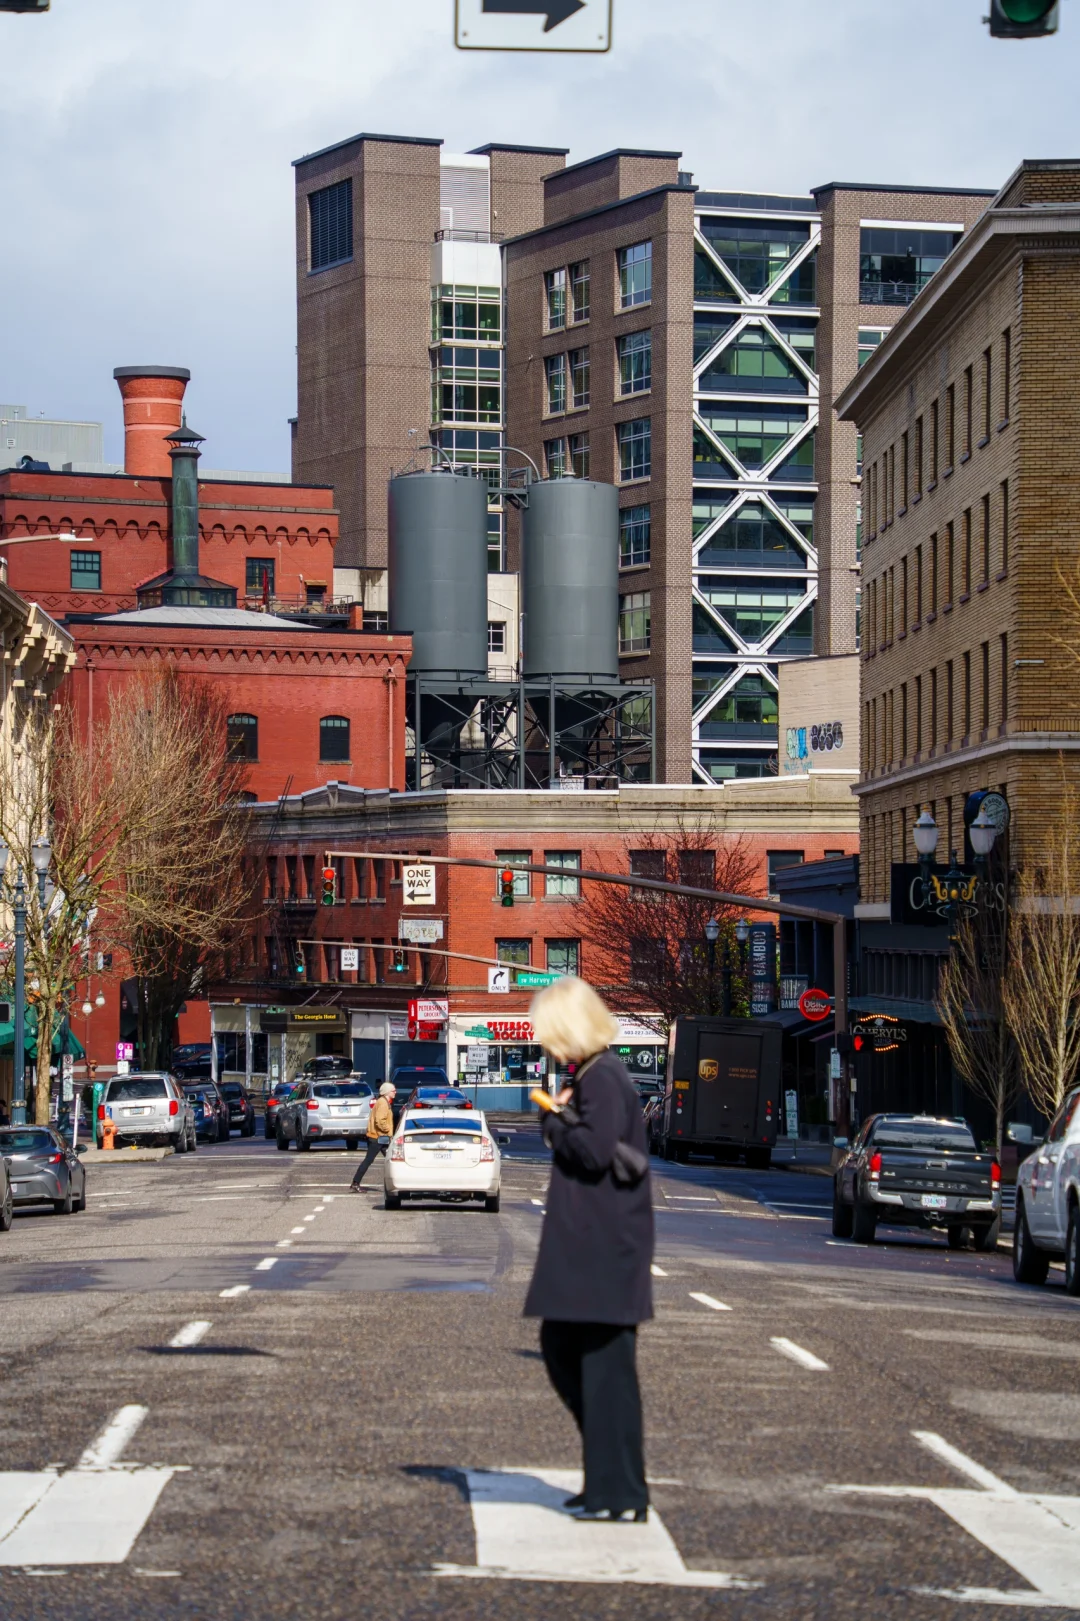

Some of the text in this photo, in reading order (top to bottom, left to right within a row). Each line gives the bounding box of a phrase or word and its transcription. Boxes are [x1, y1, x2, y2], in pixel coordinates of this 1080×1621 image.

[407, 869, 431, 878] ONE
[407, 880, 431, 888] WAY
[406, 927, 440, 938] HOTEL
[753, 931, 766, 976] BAMBOO
[752, 1003, 768, 1013] SUSHI
[487, 1022, 533, 1032] PETERSO
[494, 1032, 534, 1040] ROCERY
[700, 1066, 717, 1078] ups
[904, 1180, 968, 1190] TACOMA
